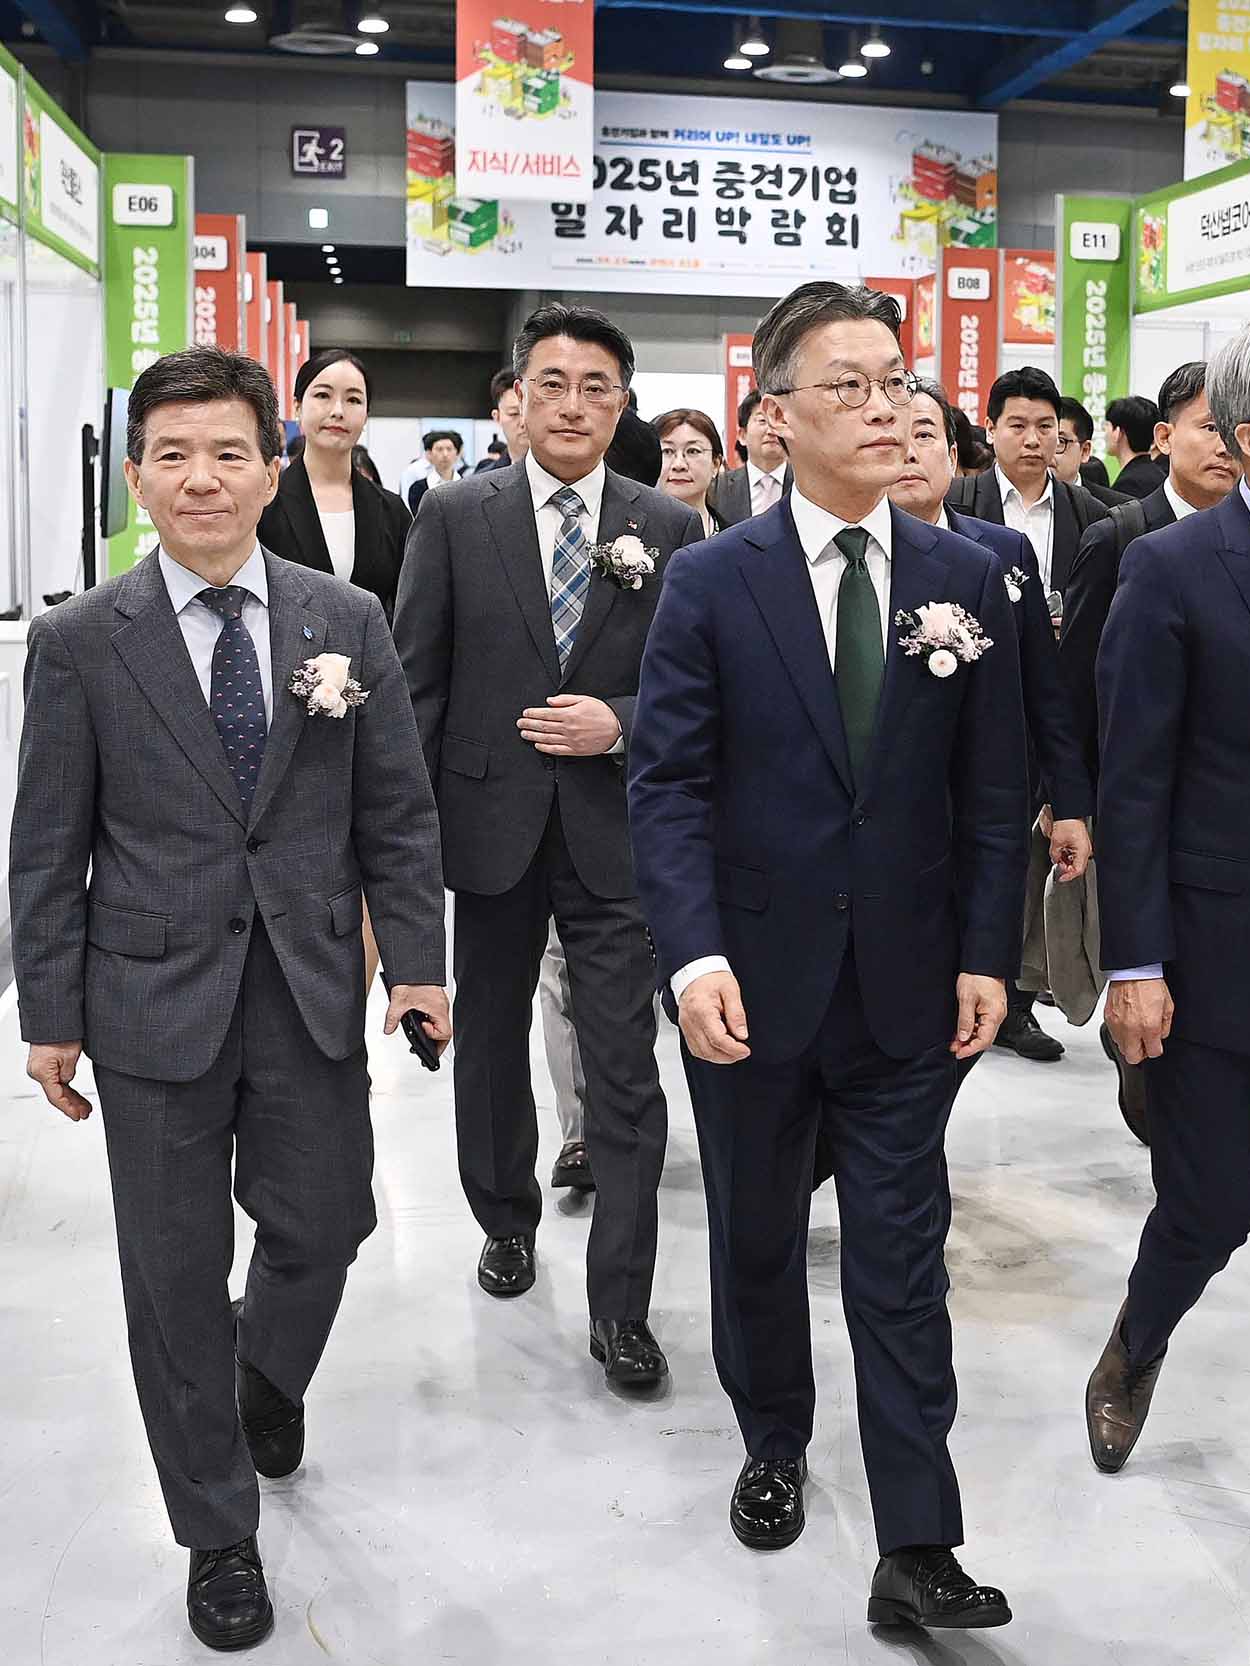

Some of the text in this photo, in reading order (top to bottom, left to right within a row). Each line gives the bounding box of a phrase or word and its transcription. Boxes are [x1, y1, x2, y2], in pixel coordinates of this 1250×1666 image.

[330, 138, 344, 160] 2
[787, 134, 811, 147] UP!
[468, 150, 581, 177] 지식/서비스
[593, 155, 857, 205] 025년 중견기업
[128, 196, 158, 212] E06
[1082, 234, 1107, 248] E11
[132, 247, 160, 343] 2025년
[1083, 280, 1107, 368] 2025년
